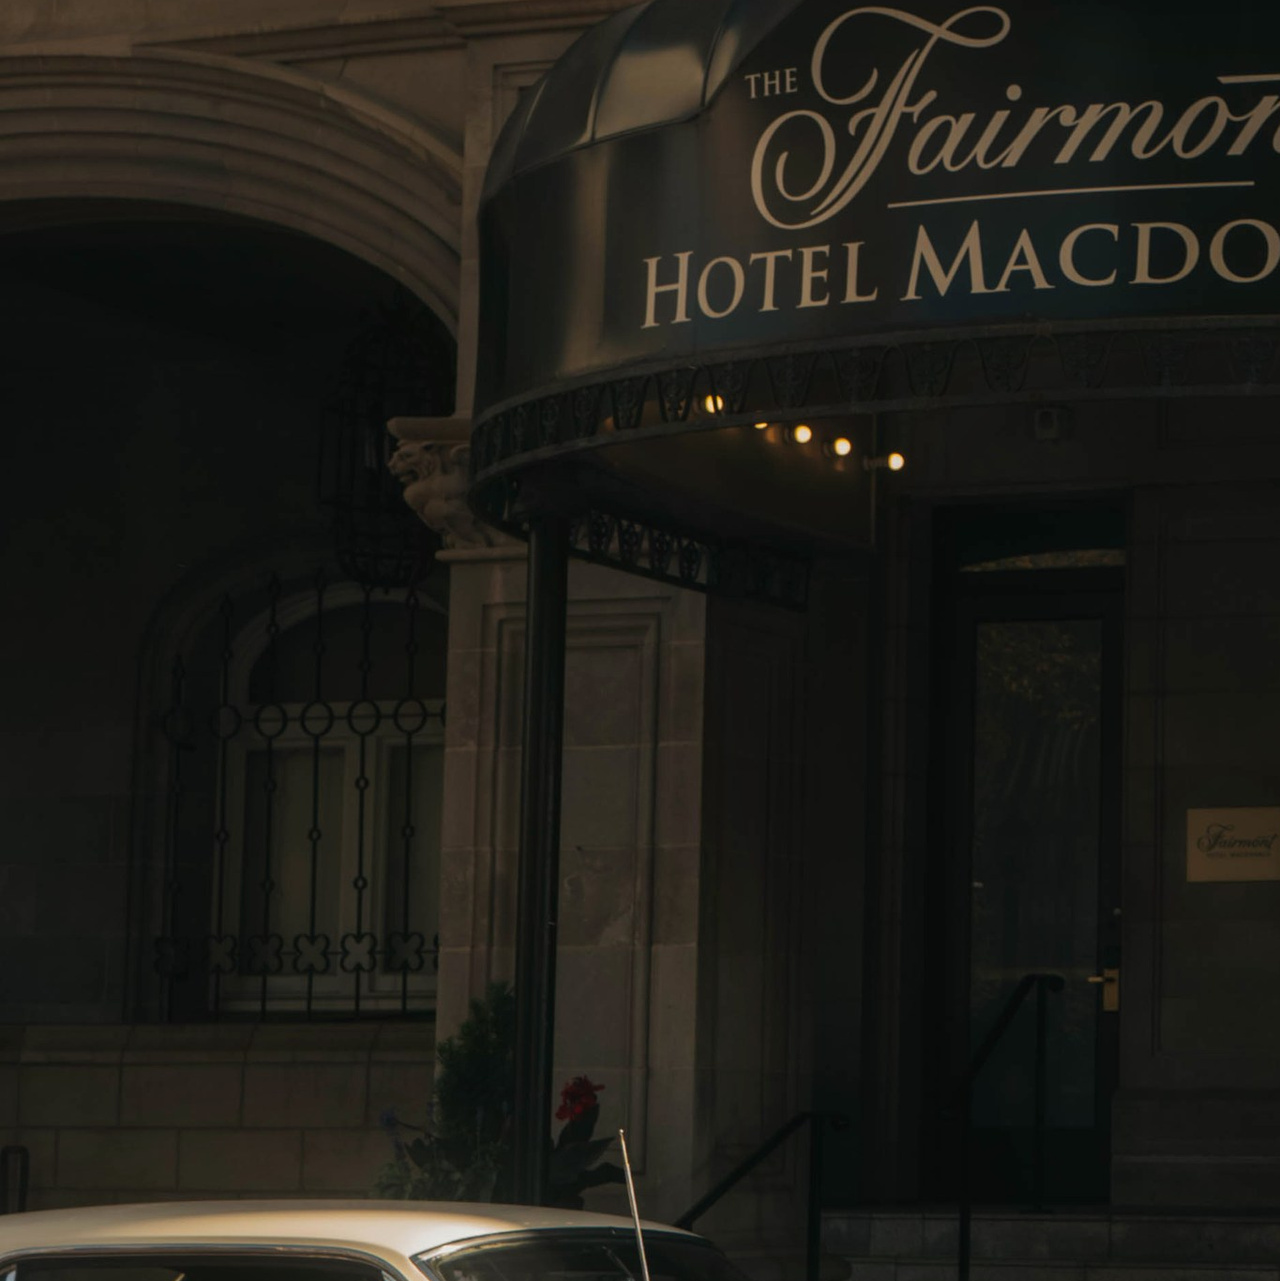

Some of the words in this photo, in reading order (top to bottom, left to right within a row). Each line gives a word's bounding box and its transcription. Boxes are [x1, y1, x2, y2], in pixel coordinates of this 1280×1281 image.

[744, 66, 800, 101] THE
[641, 241, 879, 329] HOTEL
[1196, 822, 1279, 853] Fairmont
